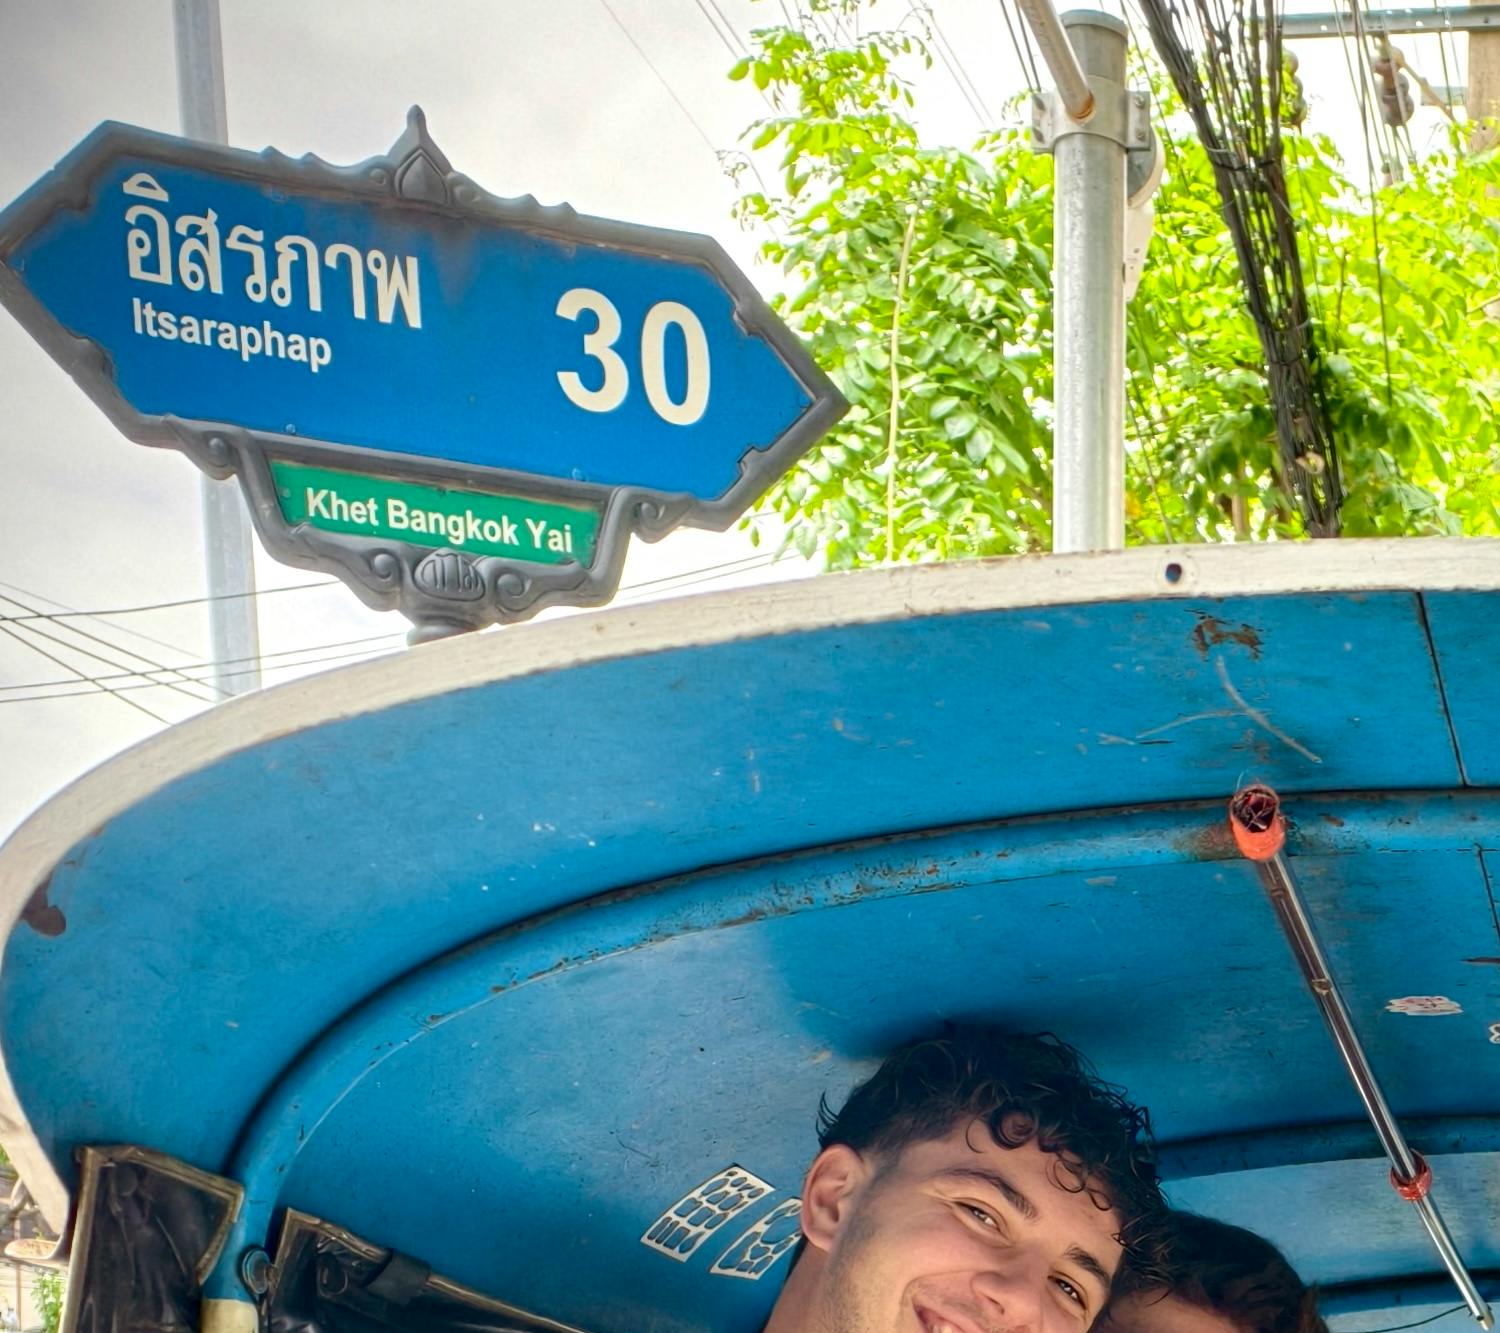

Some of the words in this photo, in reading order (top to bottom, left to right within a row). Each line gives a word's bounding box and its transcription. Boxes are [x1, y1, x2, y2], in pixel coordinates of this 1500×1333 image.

[122, 172, 422, 330] อิสรภาพ
[132, 297, 332, 372] Itsaraphap
[555, 287, 711, 426] 30
[306, 487, 378, 528] Khet
[387, 498, 519, 547] Bangkok
[526, 516, 573, 553] Yai
